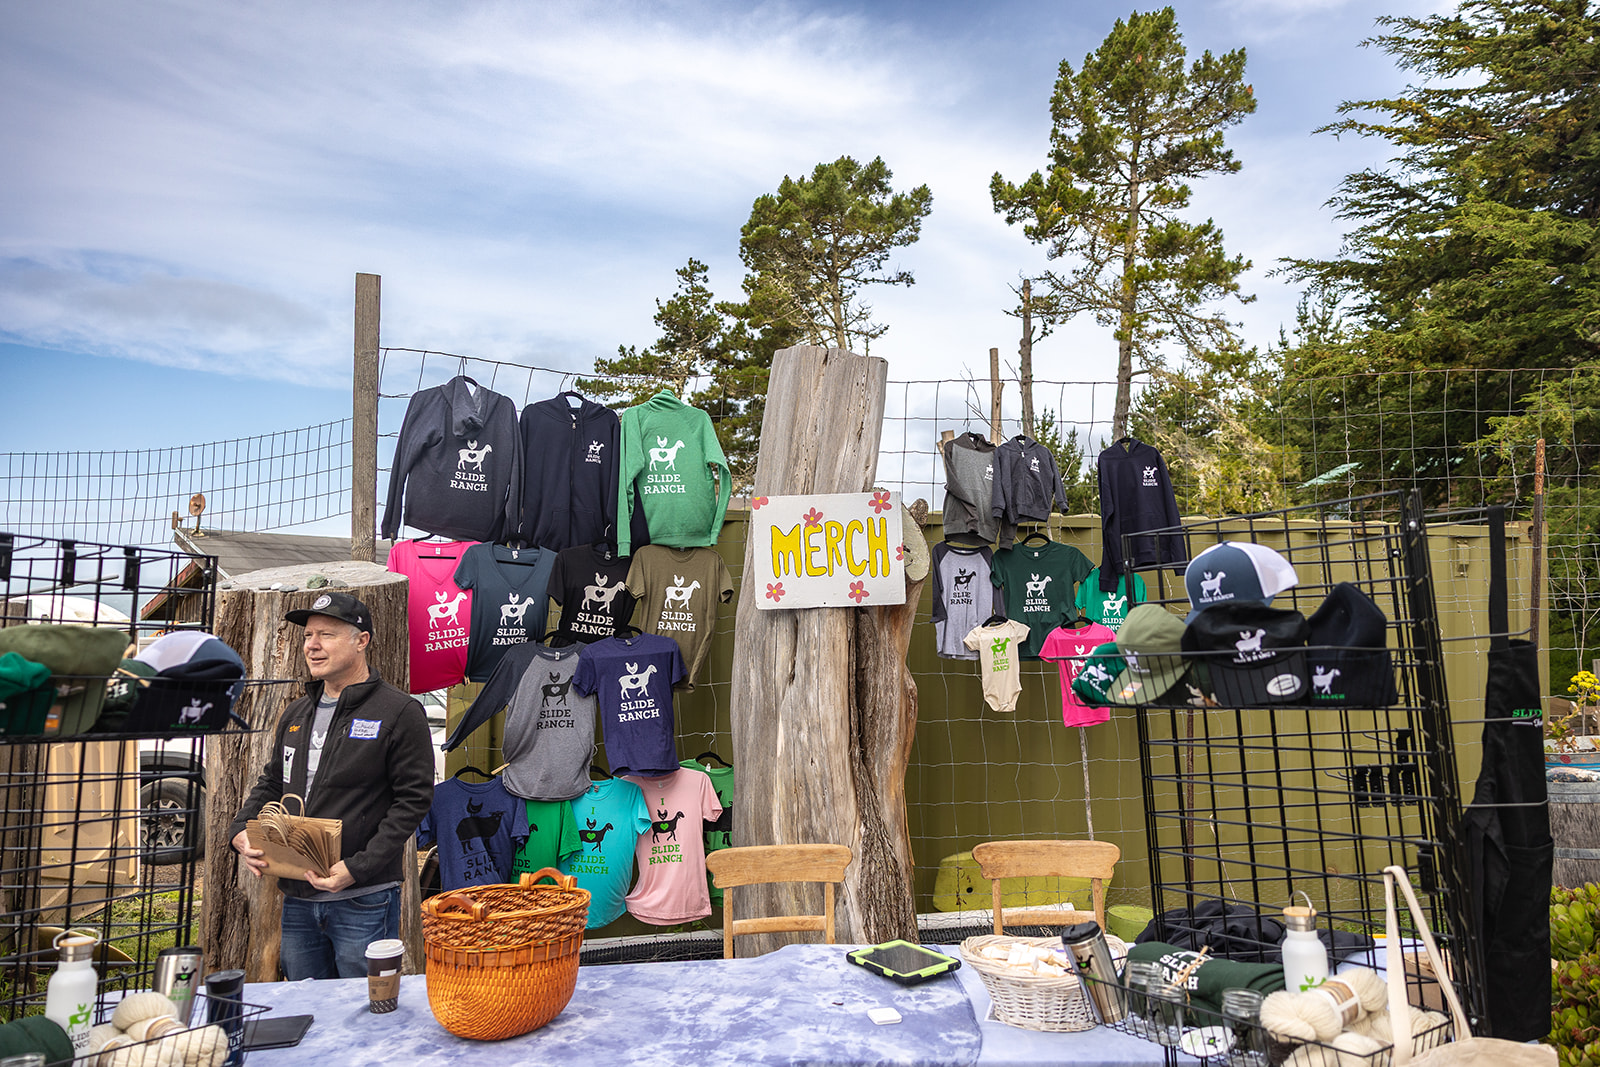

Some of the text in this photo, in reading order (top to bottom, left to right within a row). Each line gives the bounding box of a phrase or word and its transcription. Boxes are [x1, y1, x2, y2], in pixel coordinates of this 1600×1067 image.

[454, 471, 486, 482] SLIDE
[647, 474, 681, 483] SLIDE
[450, 480, 488, 492] RANCH
[643, 484, 686, 495] RANCH
[770, 516, 891, 579] MERCH
[1025, 598, 1048, 606] SLIDE
[1023, 605, 1051, 613] RANCH
[576, 612, 614, 626] SLIDE
[661, 611, 694, 622] SLIDE
[1102, 617, 1124, 625] SLIDE
[496, 628, 527, 636] SLIDE
[570, 622, 616, 637] RANCH
[657, 621, 697, 632] RANCH
[428, 627, 466, 641] SLIDE
[424, 636, 470, 652] RANCH
[492, 636, 529, 646] RANCH
[620, 698, 656, 712] SLIDE
[539, 709, 572, 719] SLIDE
[618, 708, 660, 723] RANCH
[1511, 708, 1543, 718] SLID
[536, 719, 575, 730] RANCH
[660, 797, 665, 806] I
[591, 806, 596, 815] I
[651, 844, 681, 855] SLIDE
[513, 858, 531, 869] IDE
[573, 854, 606, 864] SLIDE
[648, 854, 683, 866] RANCH
[569, 865, 609, 875] RANCH
